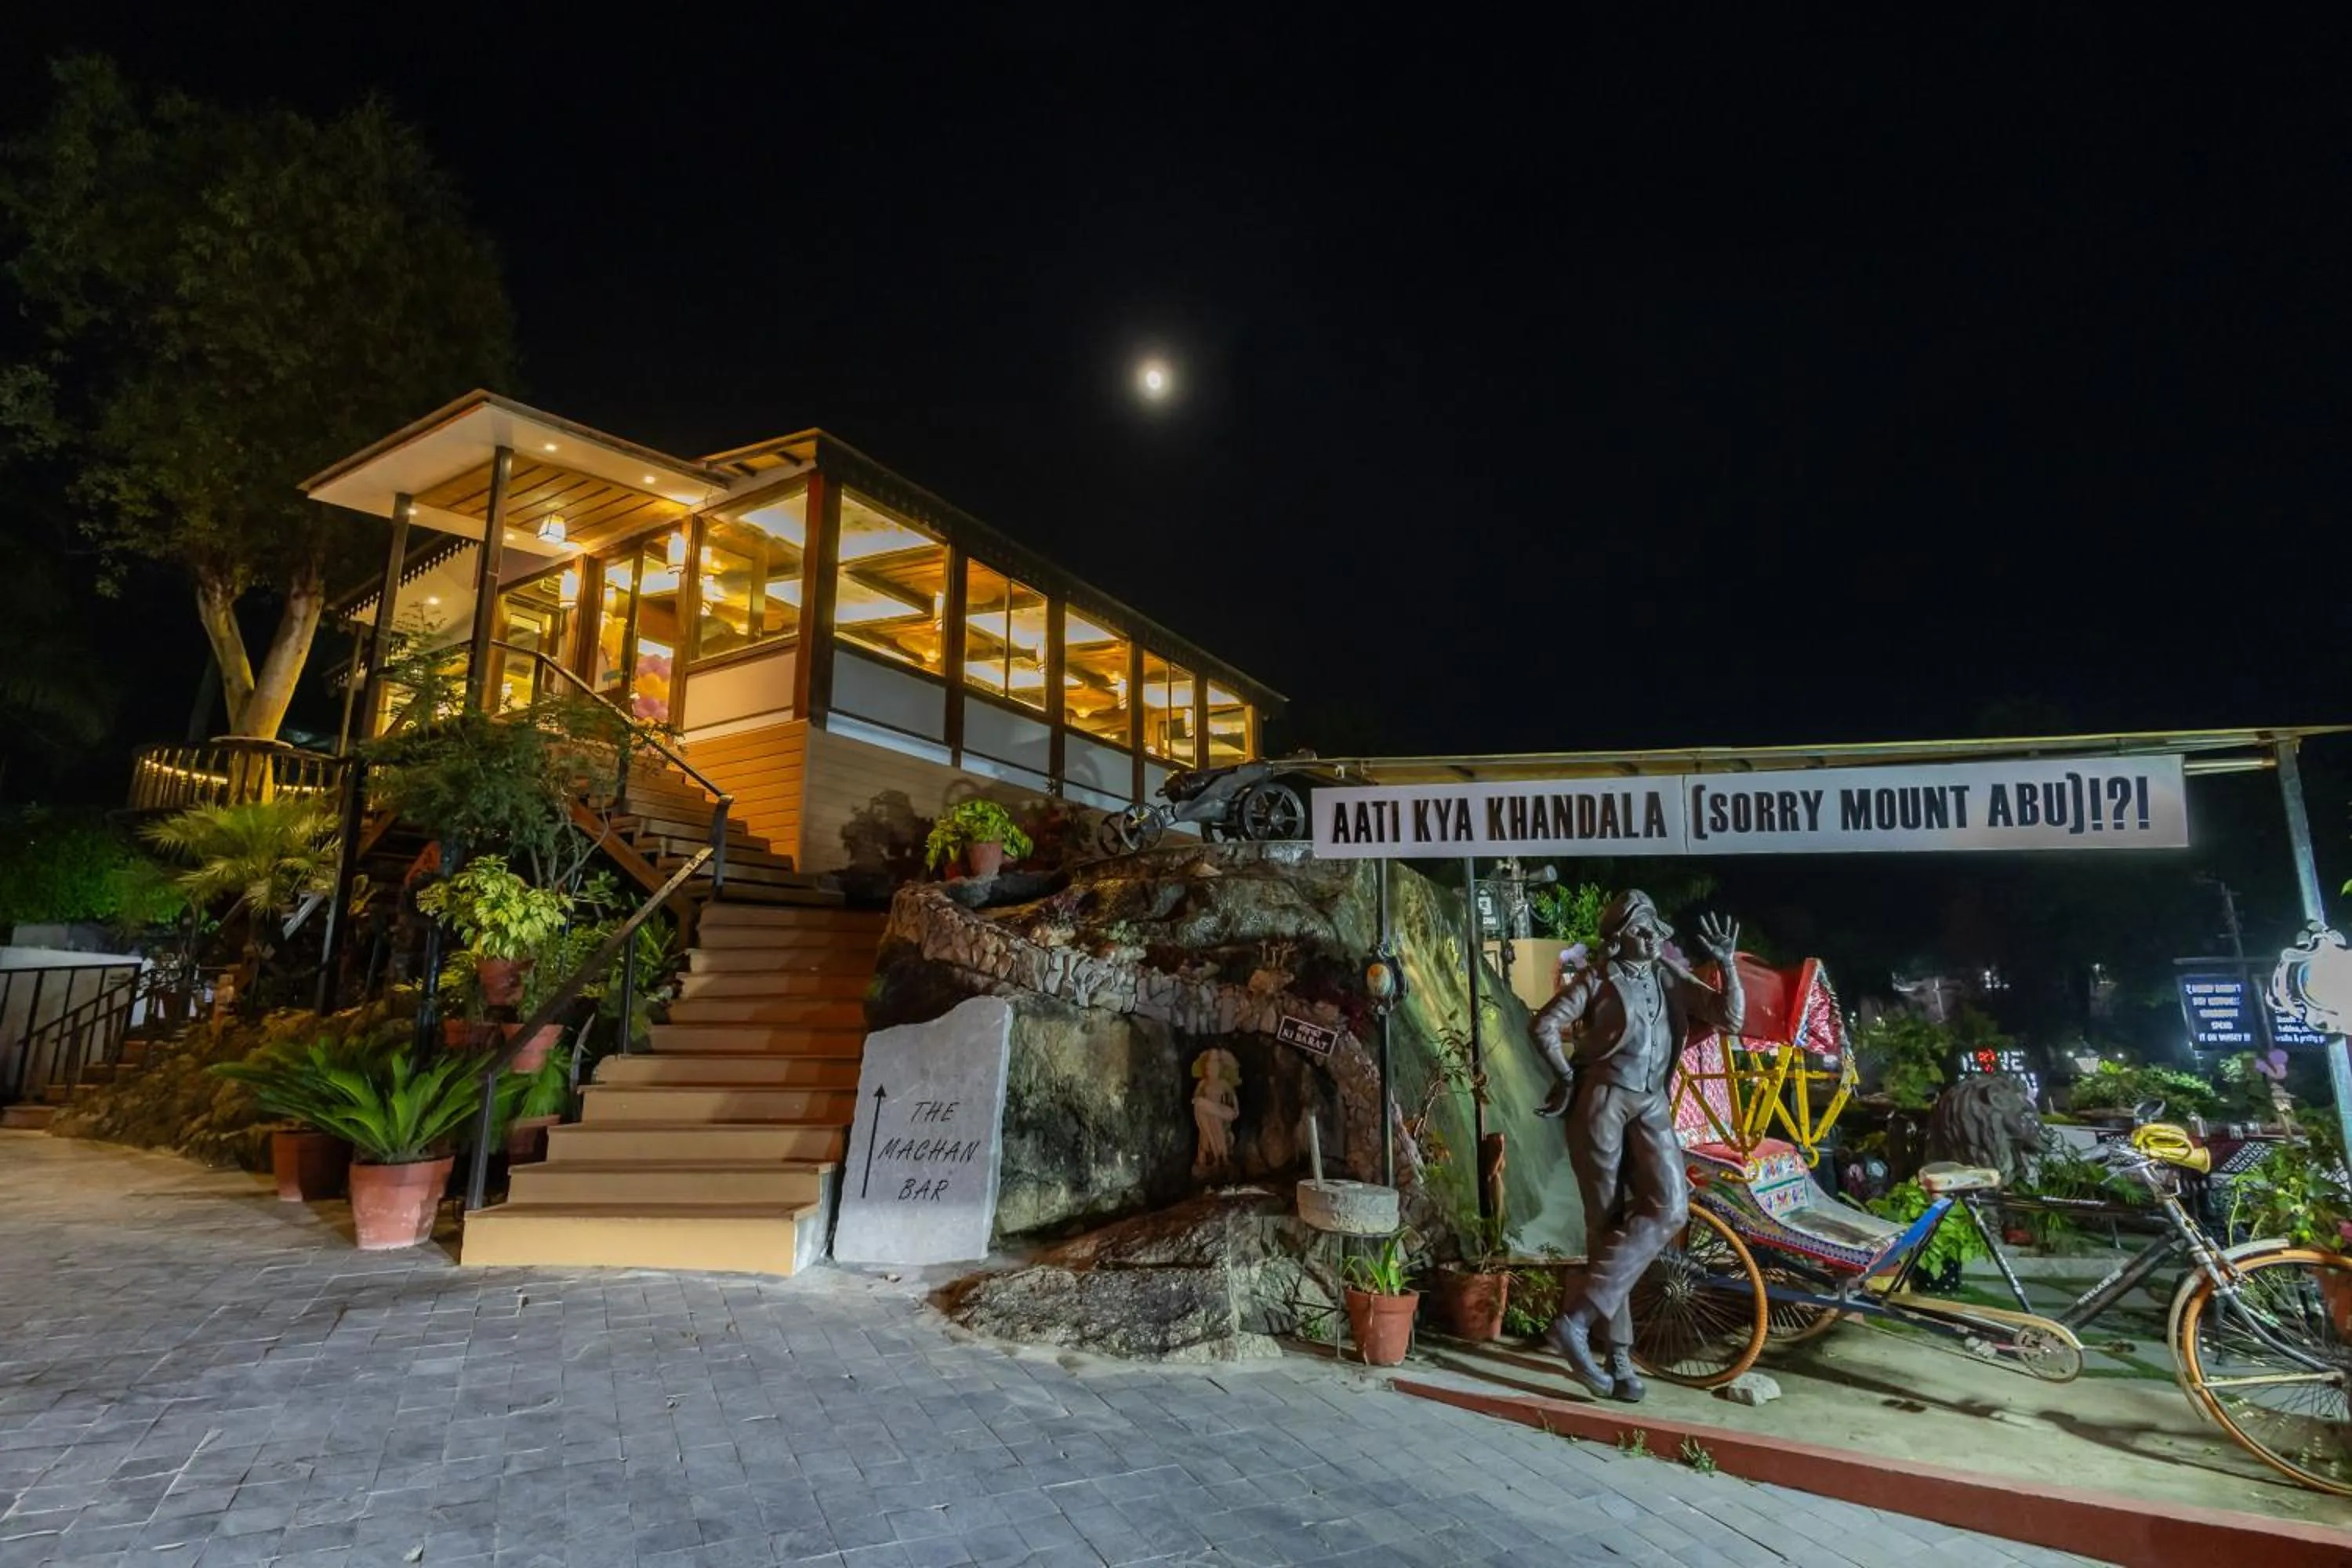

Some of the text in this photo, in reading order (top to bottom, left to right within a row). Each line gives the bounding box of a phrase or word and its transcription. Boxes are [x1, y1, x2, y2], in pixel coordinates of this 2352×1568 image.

[1332, 800, 1400, 844] AATI
[1414, 797, 1473, 842] KYA
[1486, 791, 1668, 841] KHANDALA
[1841, 785, 1969, 831] MOUNT
[910, 1101, 960, 1123] THE
[877, 1138, 981, 1163] MACHAN
[898, 1178, 949, 1202] BAR
